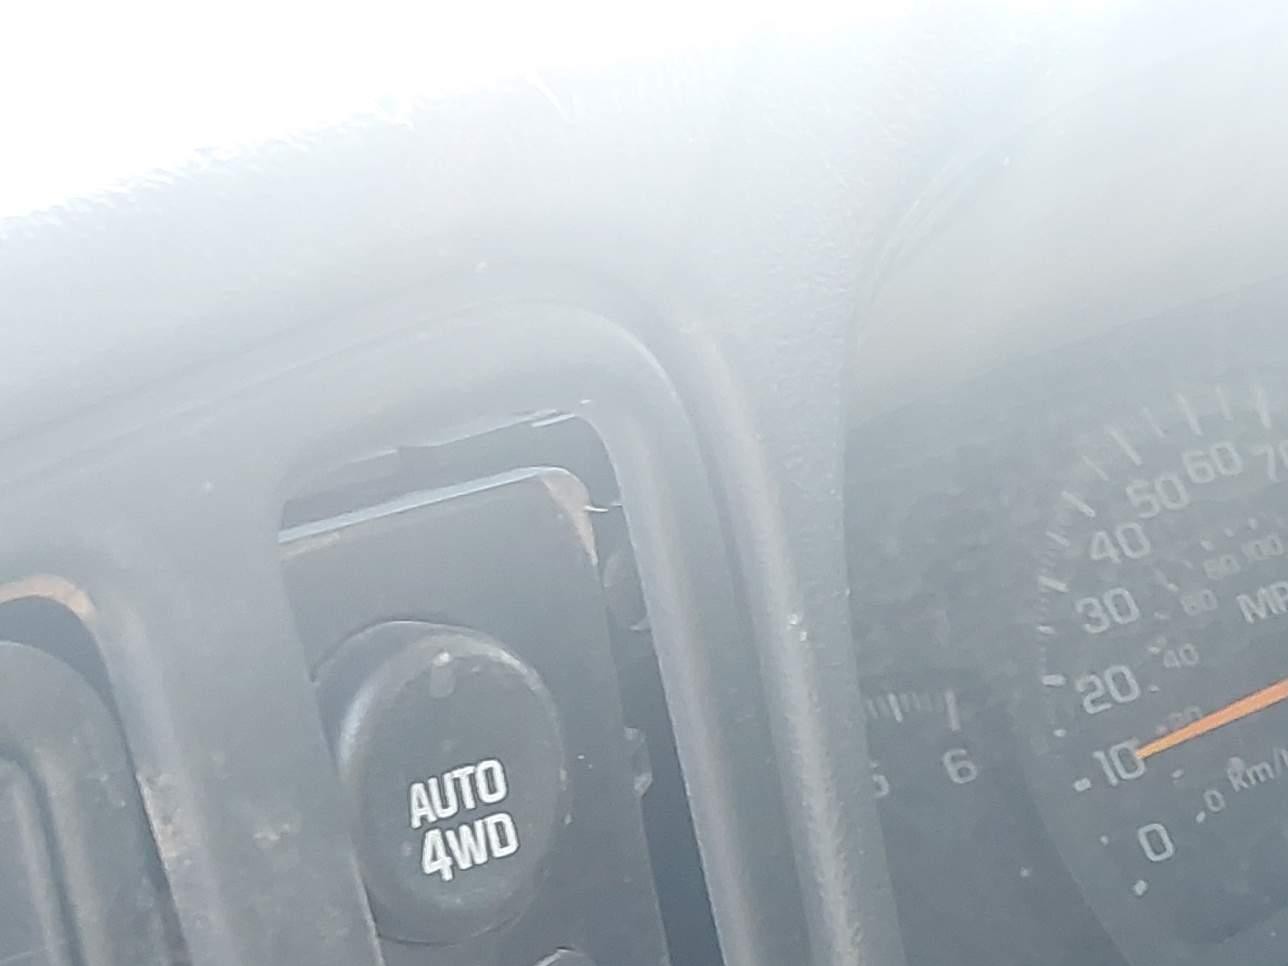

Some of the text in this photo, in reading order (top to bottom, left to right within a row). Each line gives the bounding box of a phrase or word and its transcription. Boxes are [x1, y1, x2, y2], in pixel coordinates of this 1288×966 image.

[1182, 441, 1243, 483] 60
[1126, 472, 1190, 518] 50
[1090, 522, 1151, 564] 40
[1075, 587, 1141, 634] 30
[1075, 665, 1140, 714] 20
[943, 748, 977, 784] 6
[1093, 738, 1148, 787] 10
[409, 758, 506, 828] AUTO
[1203, 788, 1226, 813] 0
[420, 811, 519, 881] 4WD
[1136, 823, 1175, 863] 0
